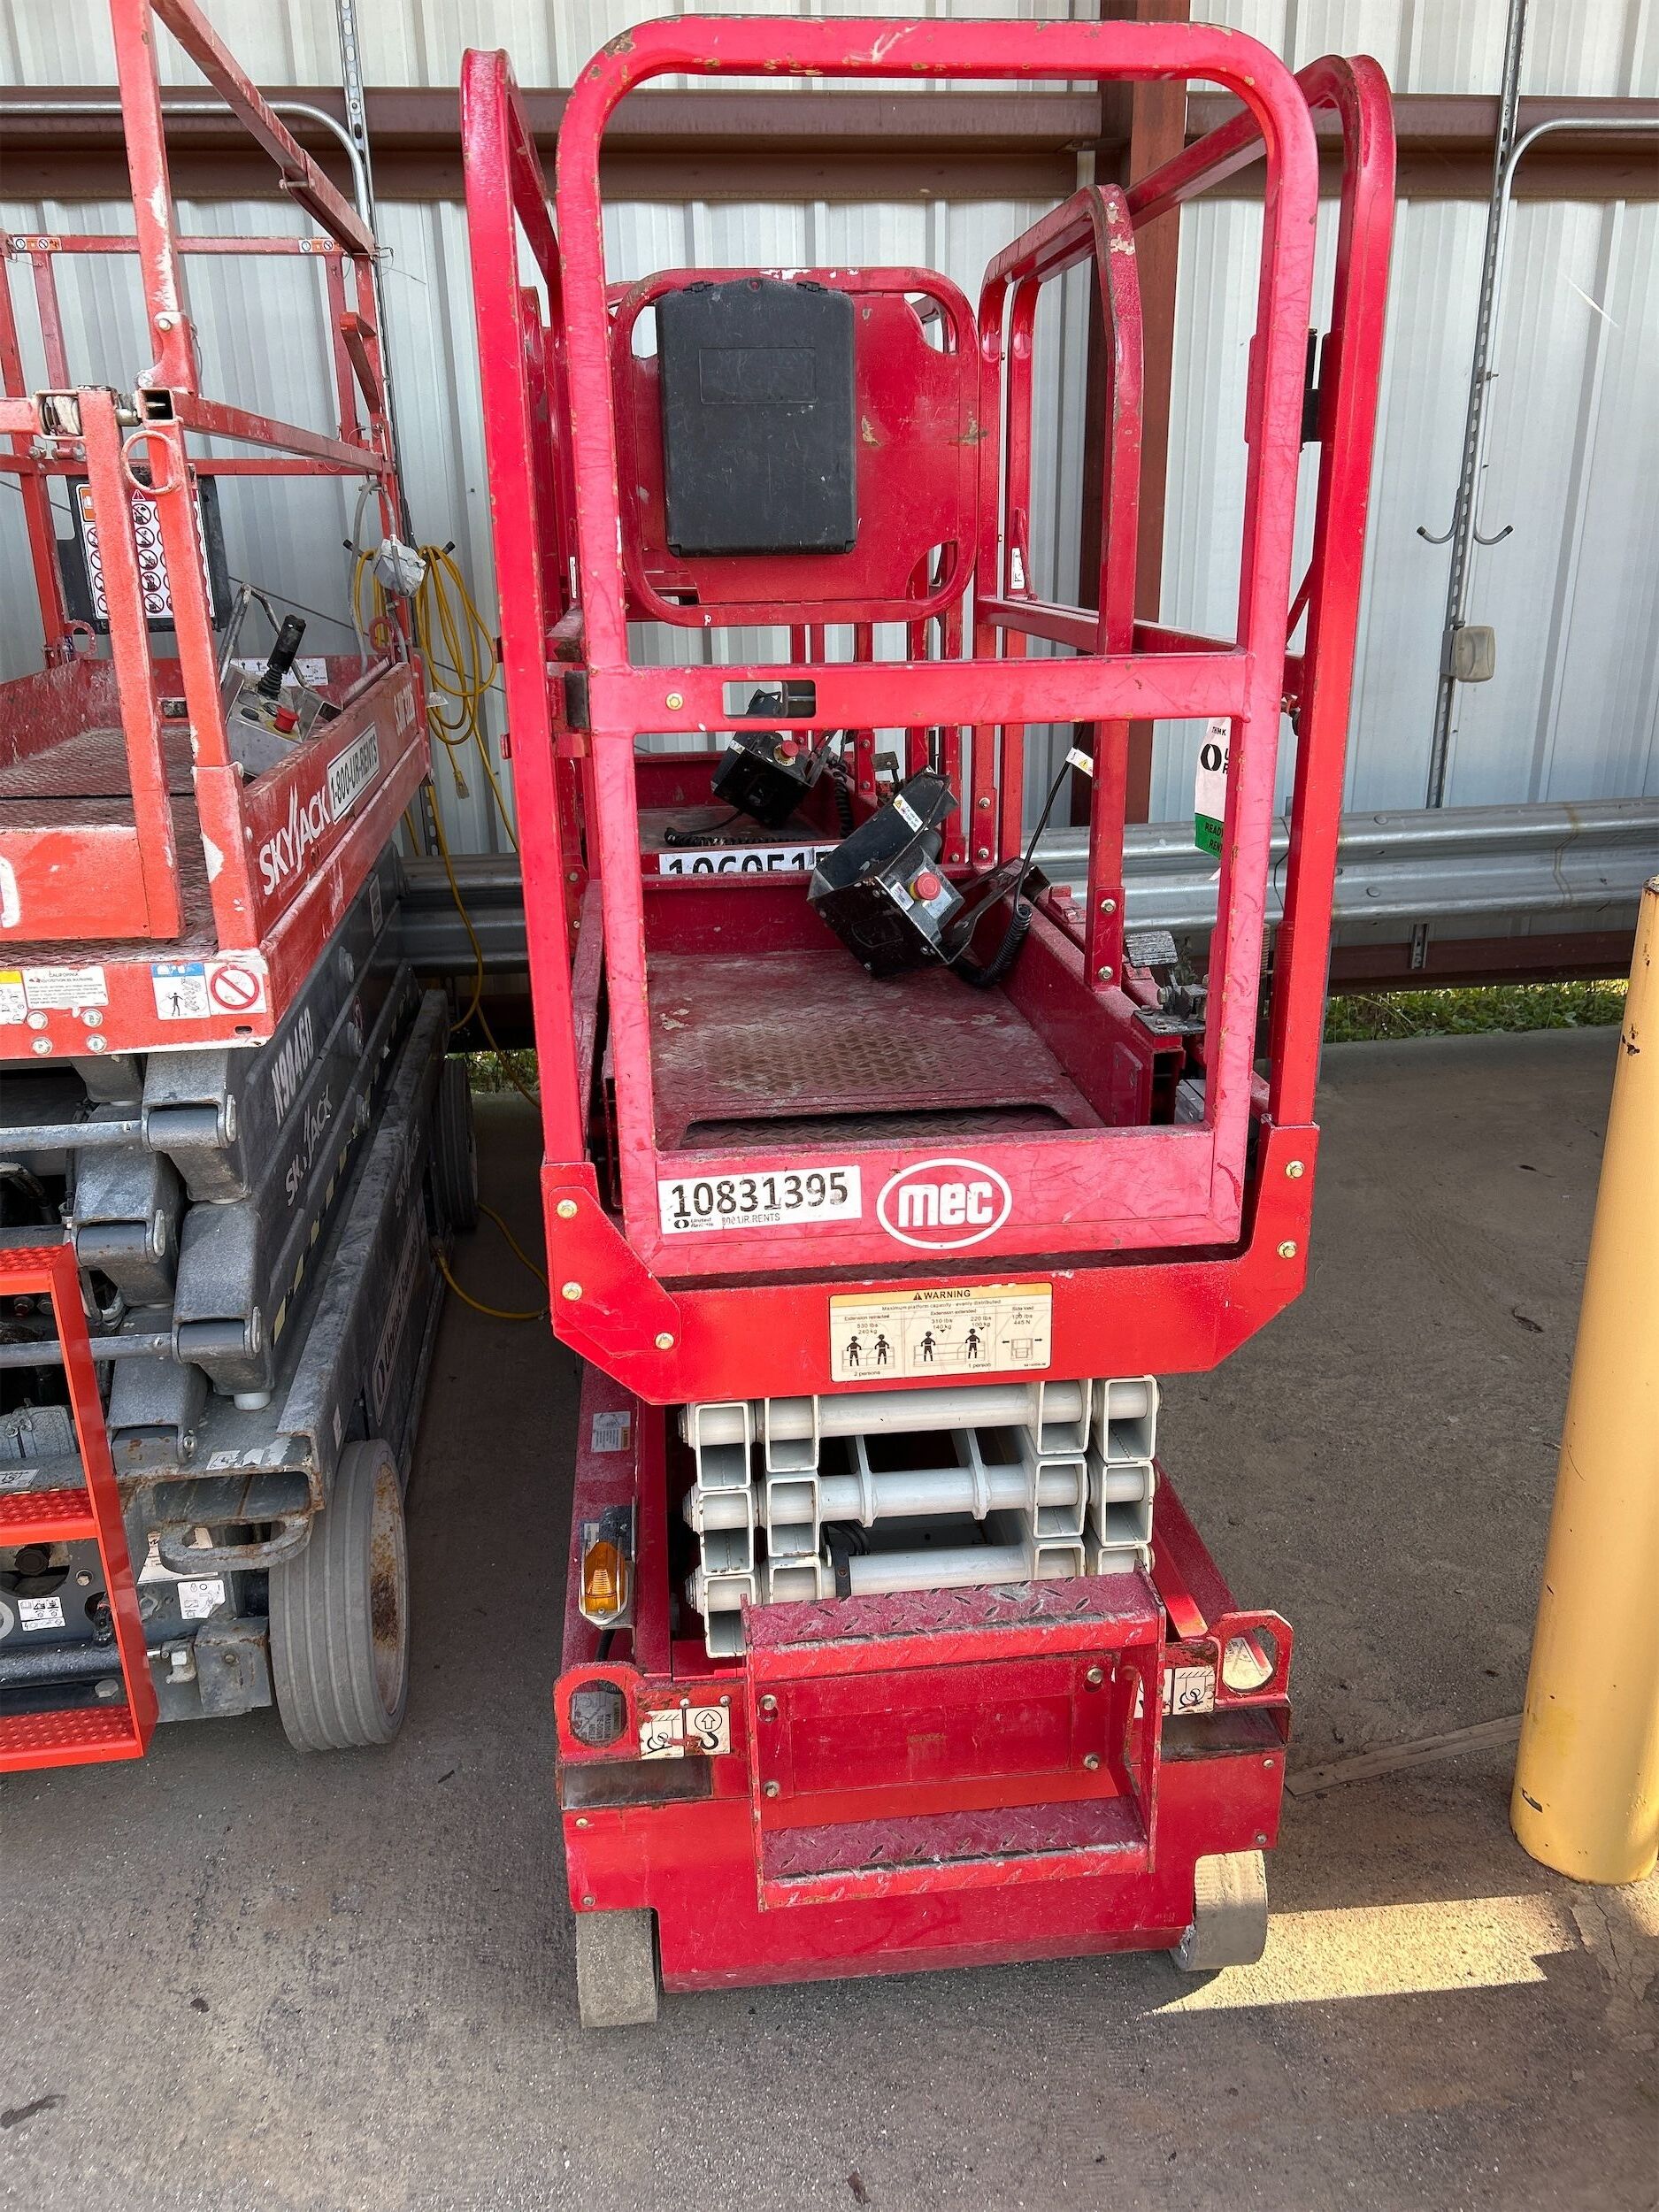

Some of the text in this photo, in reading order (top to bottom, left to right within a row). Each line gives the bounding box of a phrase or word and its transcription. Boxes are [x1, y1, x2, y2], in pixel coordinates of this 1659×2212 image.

[259, 781, 331, 896] SKYJACK
[671, 1171, 849, 1218] 10831395
[924, 1289, 971, 1300] WARNING
